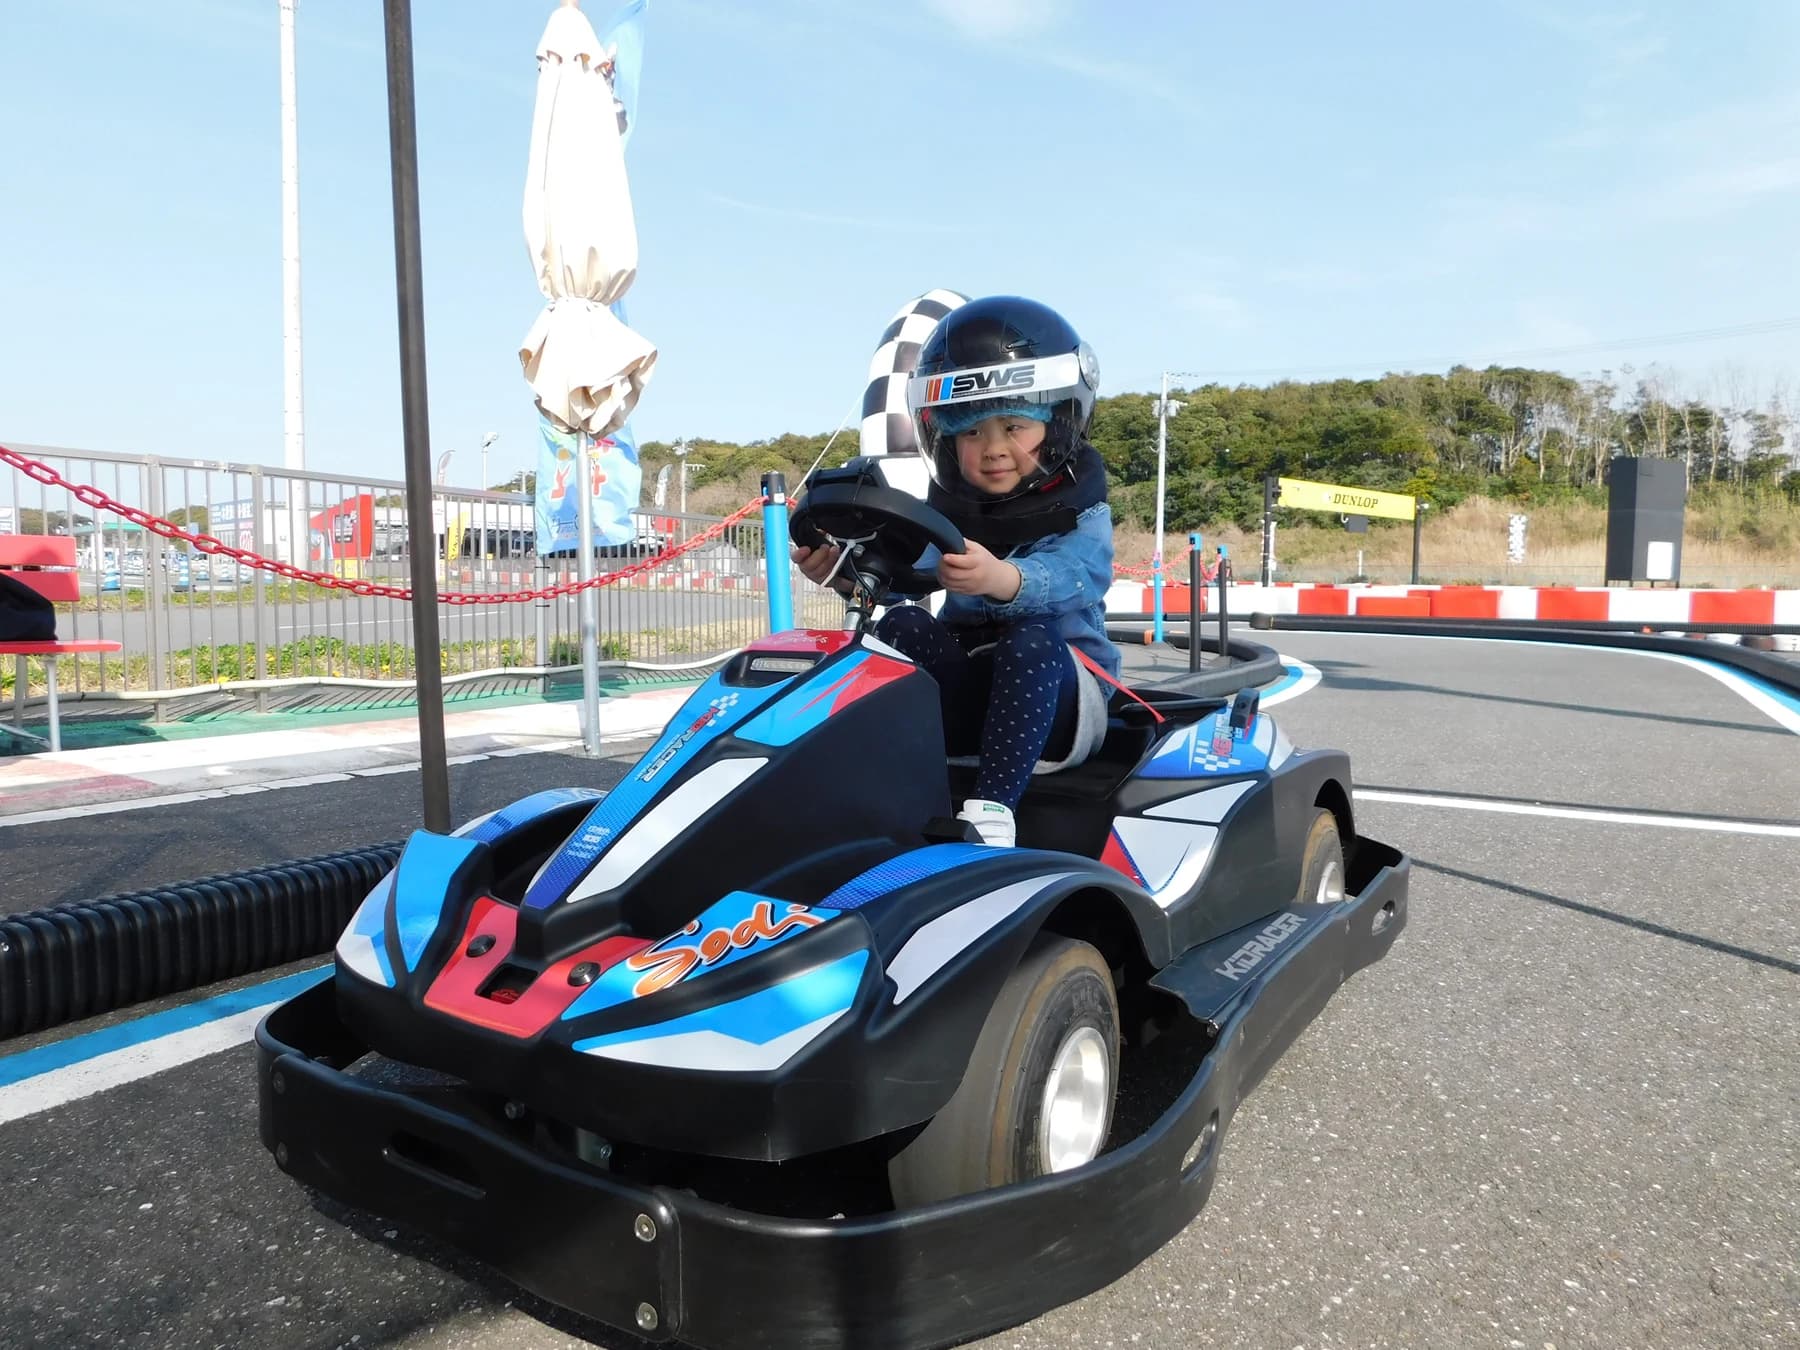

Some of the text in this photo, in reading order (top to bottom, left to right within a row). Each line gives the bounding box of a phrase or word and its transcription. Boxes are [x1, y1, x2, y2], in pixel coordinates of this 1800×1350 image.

[952, 365, 1035, 393] SWS
[1333, 493, 1379, 509] DUNLOP
[626, 901, 826, 998] Sodi
[1215, 912, 1308, 981] KIDRACER
